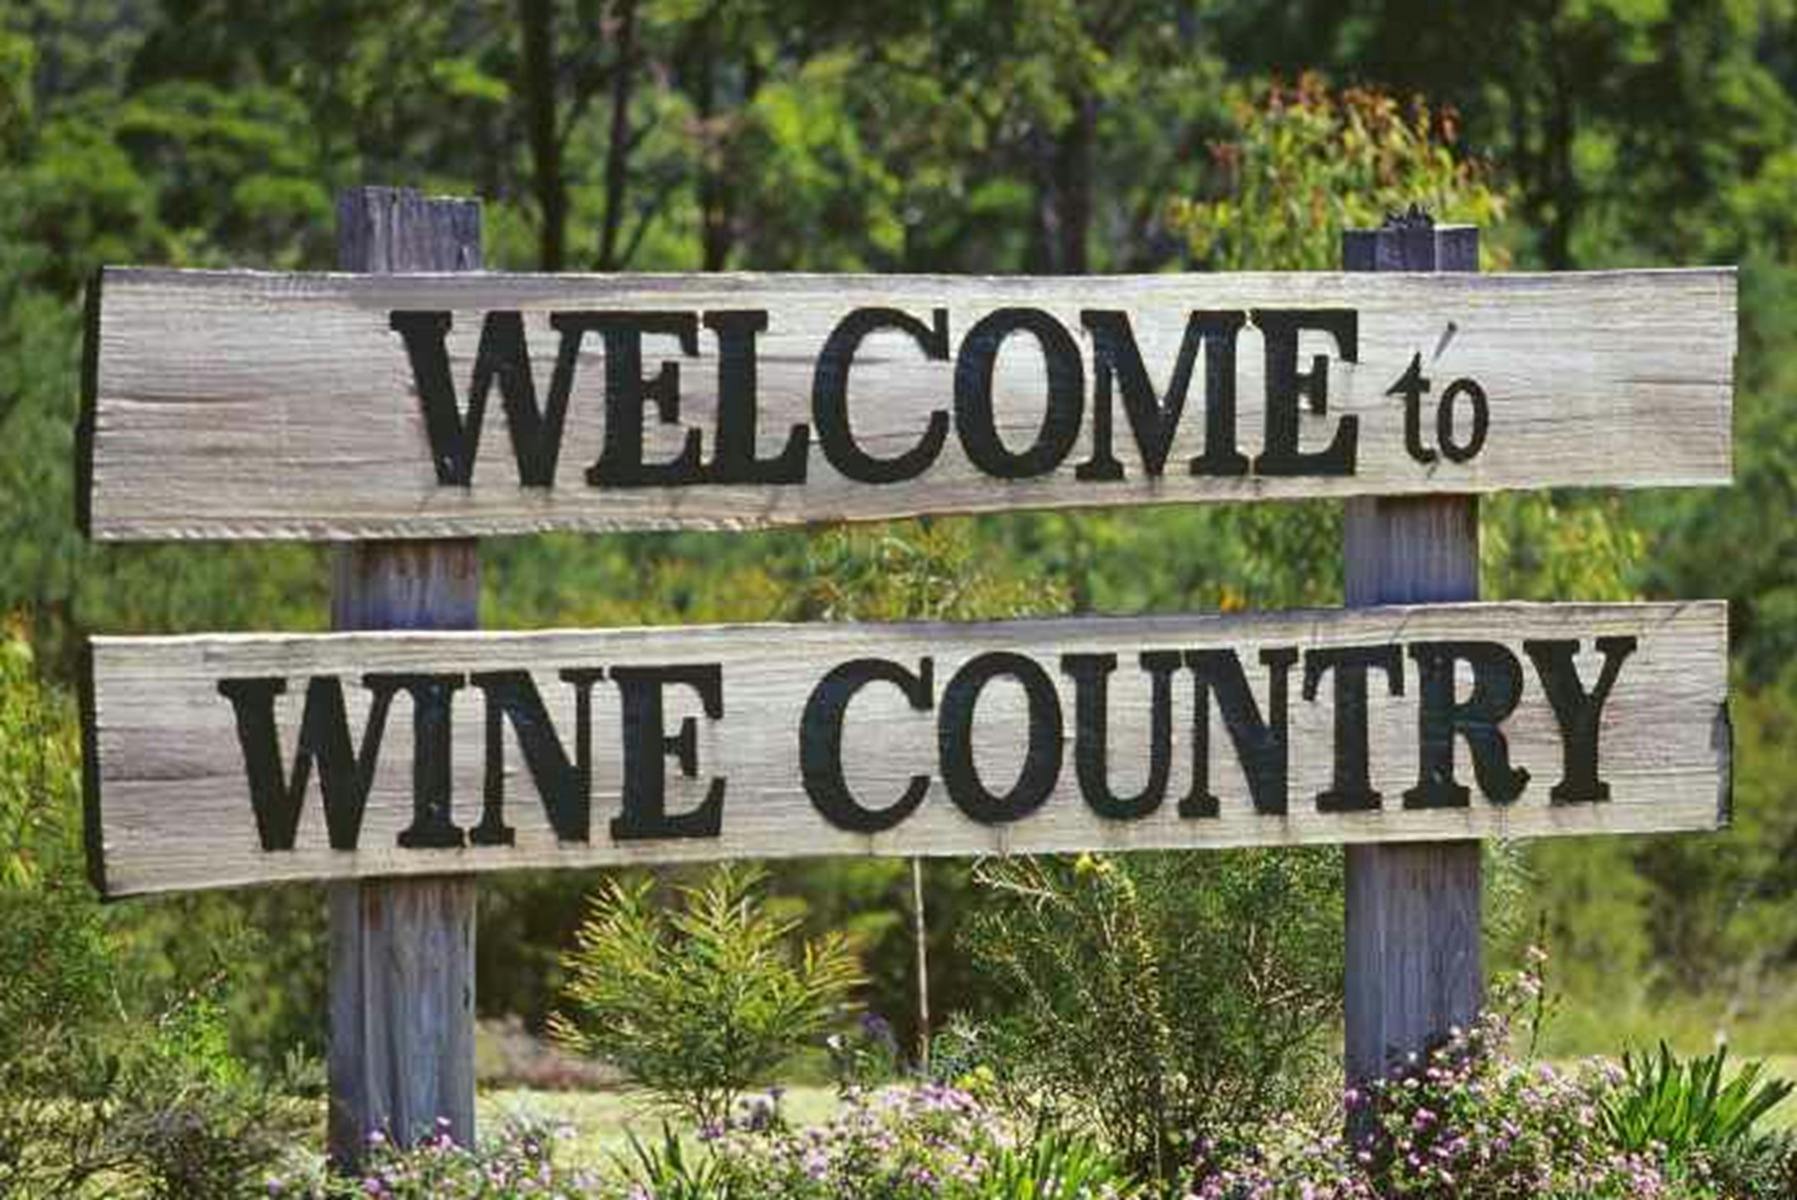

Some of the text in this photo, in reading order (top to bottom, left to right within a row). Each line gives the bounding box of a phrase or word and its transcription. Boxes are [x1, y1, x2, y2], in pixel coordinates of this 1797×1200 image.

[389, 307, 1490, 488] WELCOME to
[217, 635, 1637, 852] WINE COUNTRY
